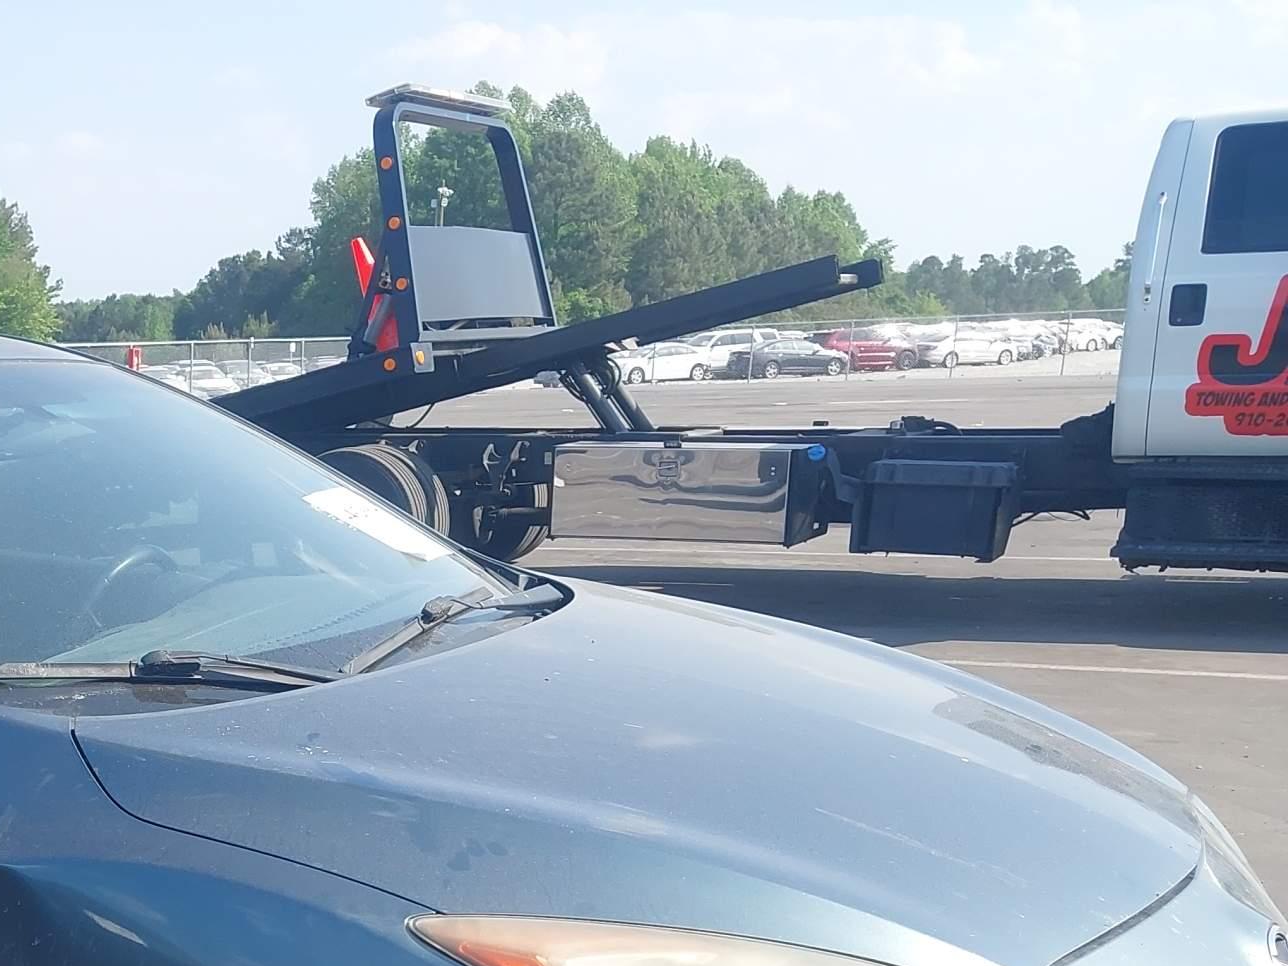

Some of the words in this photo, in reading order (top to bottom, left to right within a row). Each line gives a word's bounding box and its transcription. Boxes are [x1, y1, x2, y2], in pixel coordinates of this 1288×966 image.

[1196, 391, 1256, 407] TOWING
[1257, 391, 1288, 407] AND
[1235, 412, 1288, 427] 910-2
